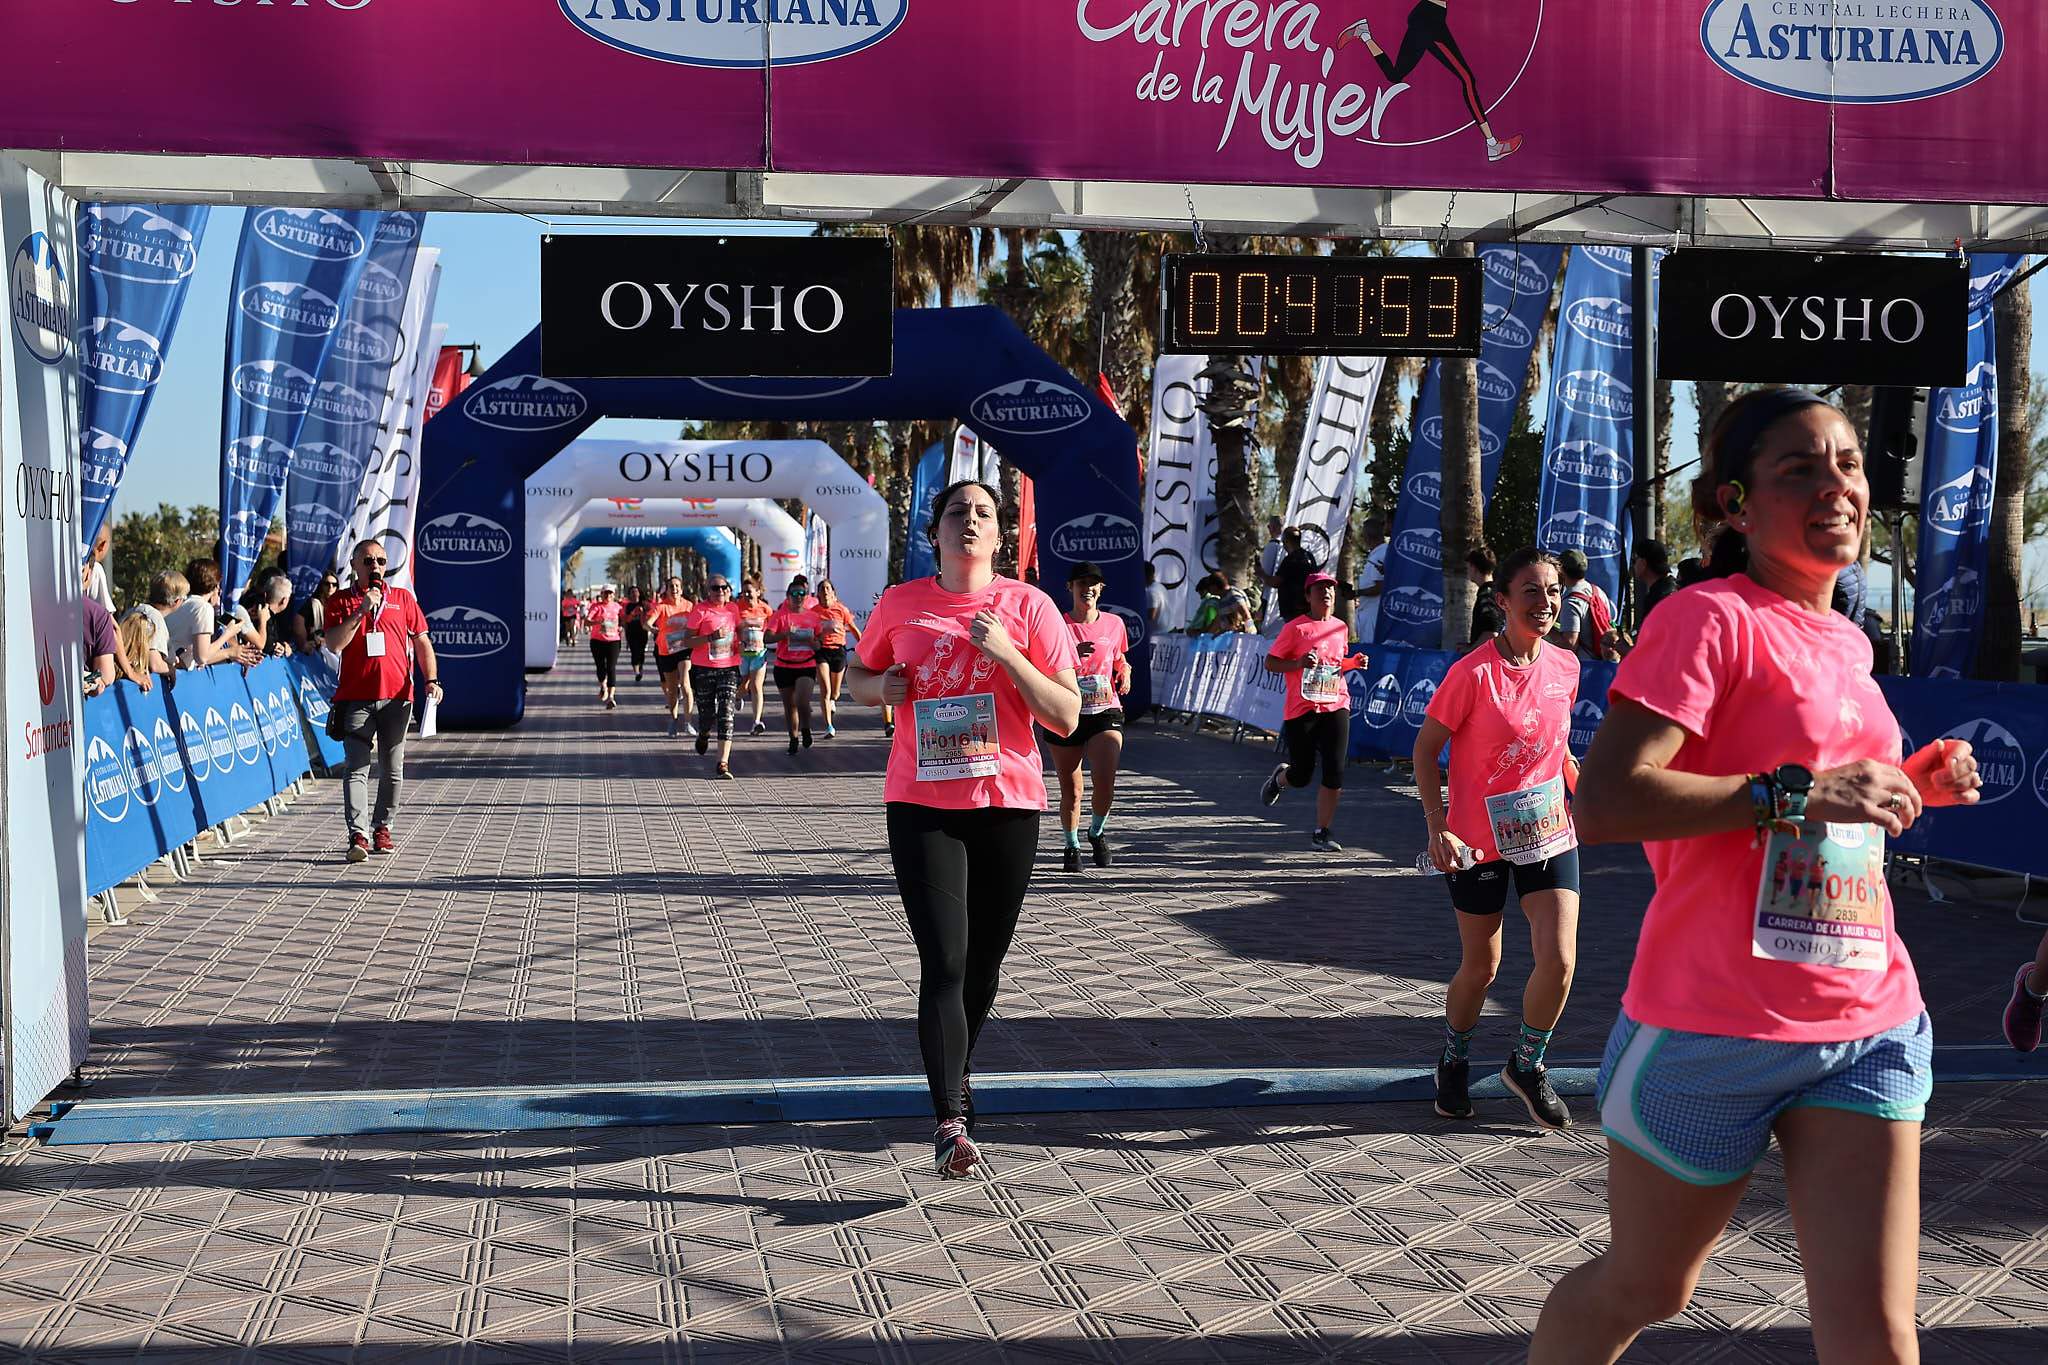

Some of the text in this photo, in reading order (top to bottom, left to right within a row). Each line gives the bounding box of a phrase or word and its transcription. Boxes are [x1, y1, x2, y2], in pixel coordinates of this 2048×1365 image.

[585, 0, 882, 27] STURIANA
[1773, 2, 1971, 21] CENTRAL LECHERA
[1724, 3, 1981, 66] ASTURIANA
[1136, 50, 1223, 104] de la
[1216, 48, 1411, 169] Mujer
[262, 215, 355, 254] ASTURIANA
[83, 234, 185, 273] STURIAN
[16, 268, 69, 339] ASTURIANA
[600, 281, 844, 333] OYSHO
[1188, 271, 1459, 338] 00:41:53
[1710, 293, 1925, 344] OYSHO
[312, 399, 369, 420] STURIANA
[472, 395, 577, 417] ASTURIANA
[981, 401, 1085, 421] ASTURIANA
[619, 451, 773, 483] OYSHO
[16, 462, 74, 524] OYSHO
[526, 486, 574, 498] OYSHO
[816, 484, 862, 497] OYSHO
[1150, 381, 1199, 590] OYSHO
[422, 532, 505, 553] ASTURIANA
[840, 548, 882, 559] OYSHO
[1056, 532, 1137, 553] ASTURIANA
[524, 548, 549, 560] SHO
[430, 630, 504, 645] STURIANA
[25, 720, 73, 760] Santander
[938, 732, 971, 749] 016
[1522, 816, 1550, 835] 016
[1826, 873, 1867, 903] 016
[1768, 915, 1813, 932] CARRERA
[1816, 922, 1827, 934] DE
[1830, 923, 1841, 935] LA
[1835, 908, 1858, 922] 2839
[1774, 935, 1831, 955] OYSHO
